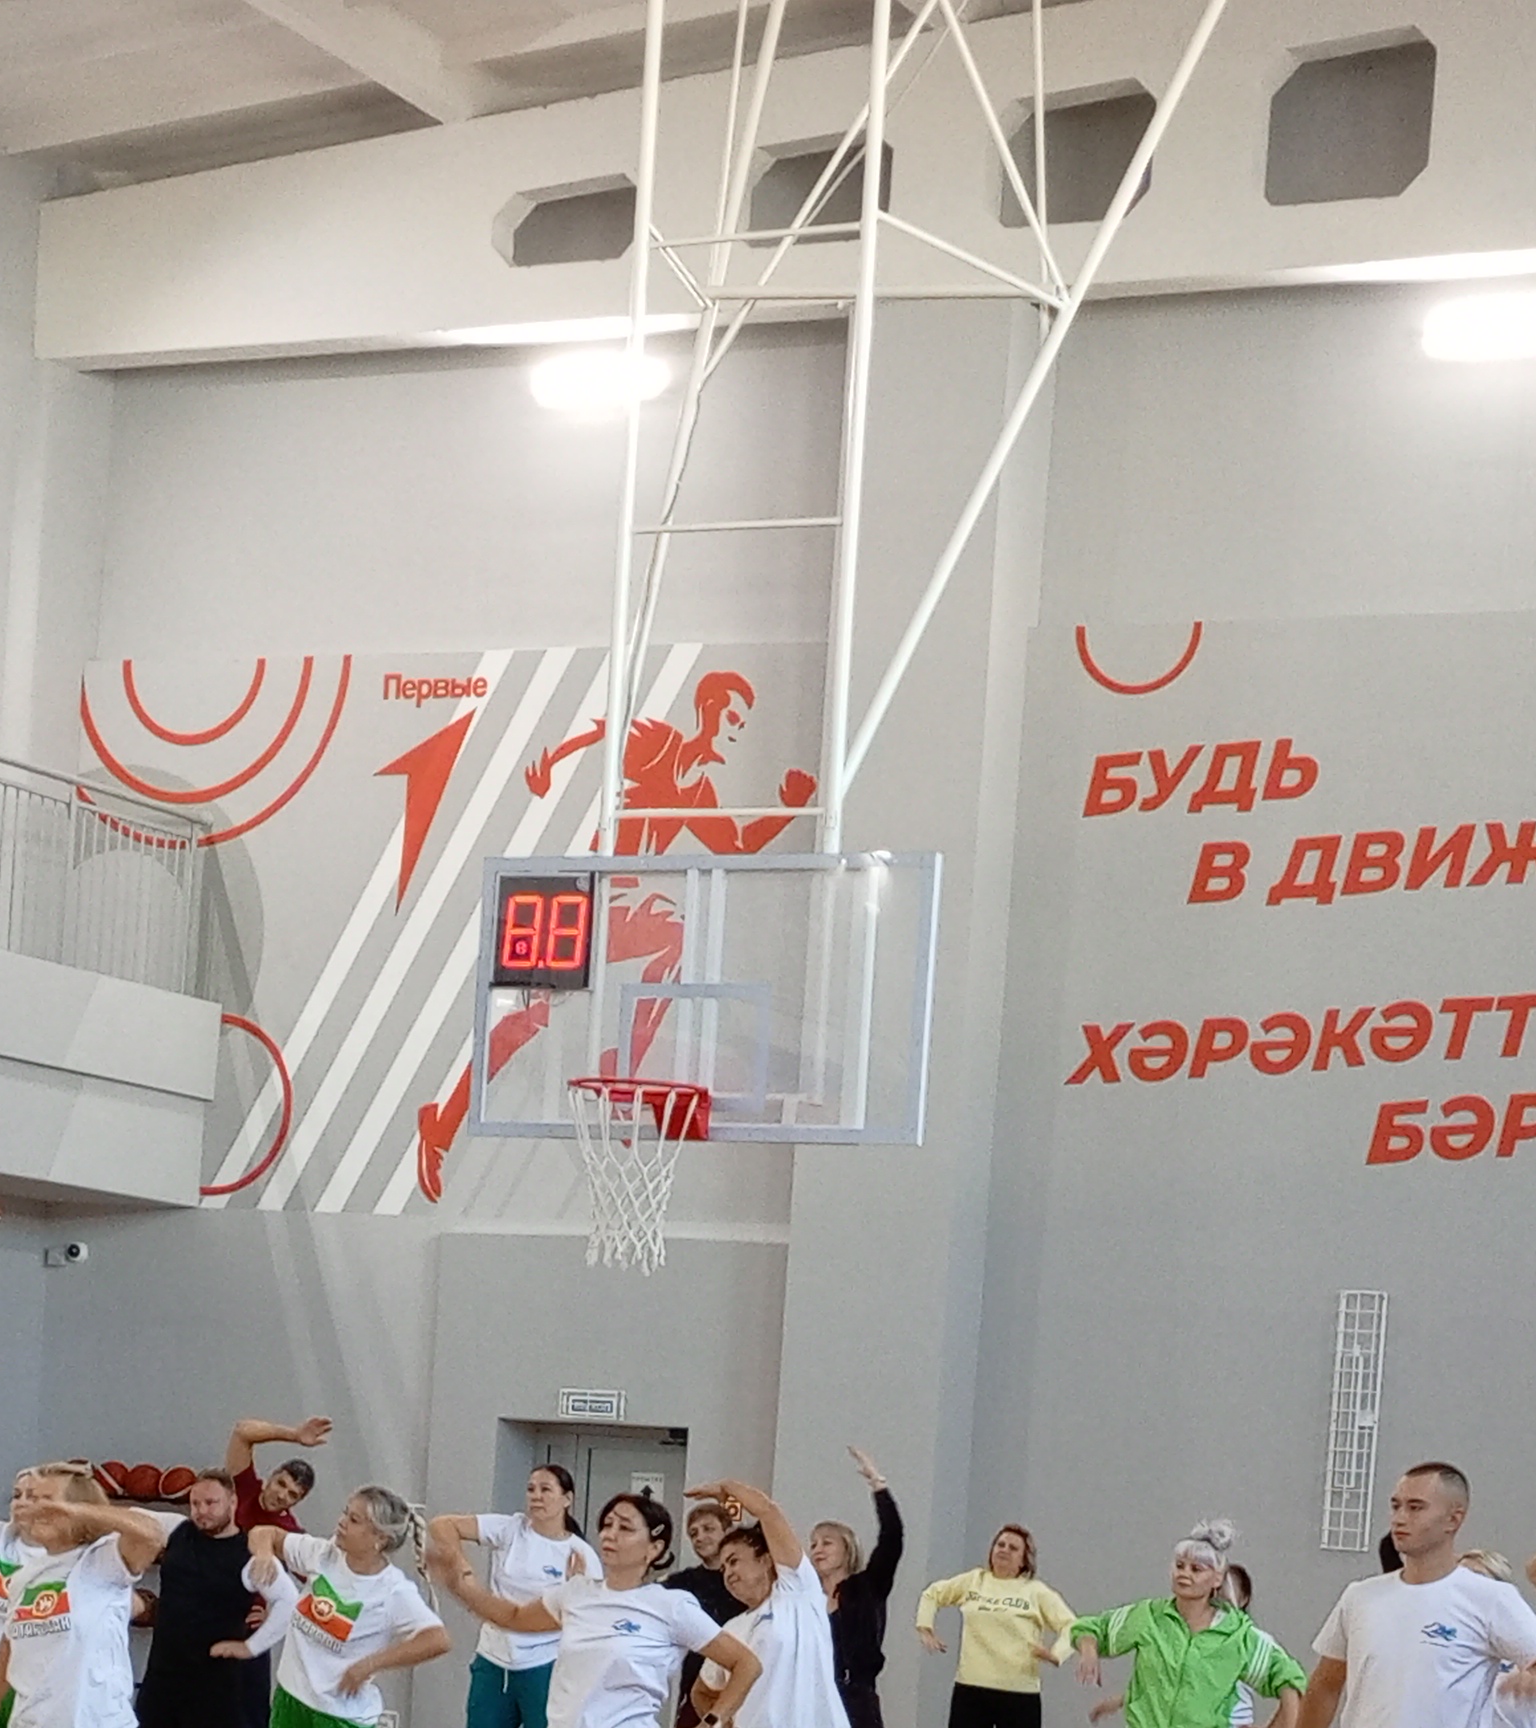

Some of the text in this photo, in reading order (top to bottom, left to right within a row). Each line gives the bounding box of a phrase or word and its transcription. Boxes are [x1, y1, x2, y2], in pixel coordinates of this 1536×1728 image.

[383, 673, 488, 708] Первые
[1082, 738, 1320, 818] БУДЬ
[1187, 840, 1251, 905] В
